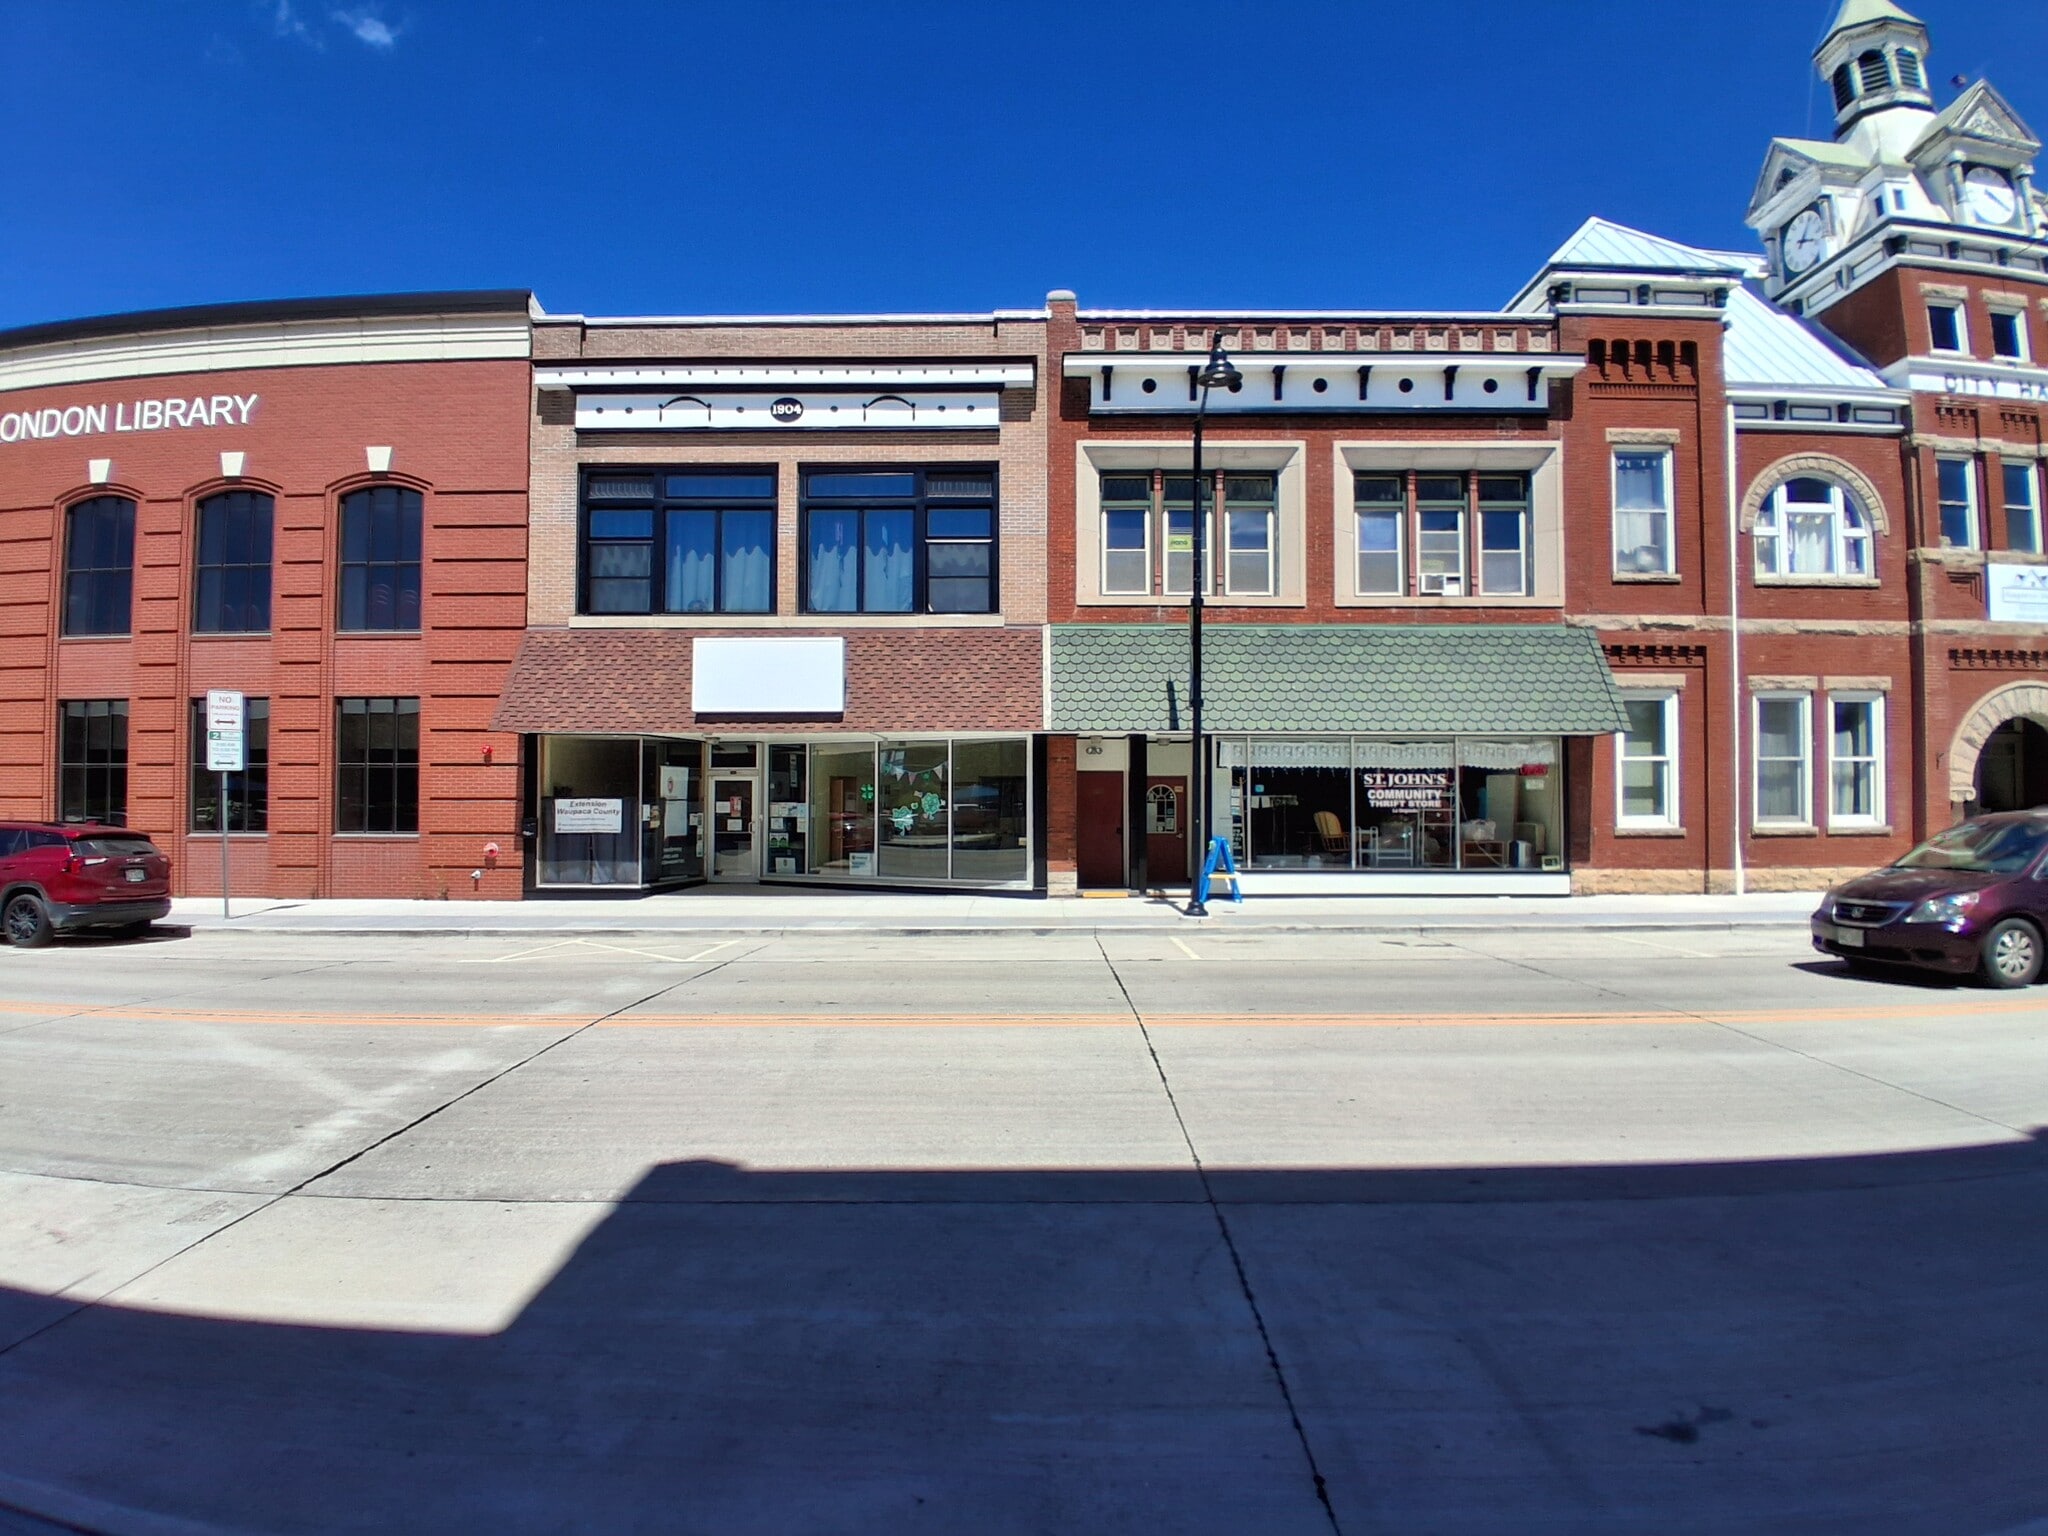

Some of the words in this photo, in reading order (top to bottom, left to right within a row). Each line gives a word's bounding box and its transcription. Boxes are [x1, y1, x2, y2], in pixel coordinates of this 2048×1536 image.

[1943, 373, 2000, 396] CITY
[772, 404, 802, 415] 1904
[0, 403, 107, 442] ONDON
[115, 394, 258, 431] LIBRARY
[1367, 789, 1443, 799] COMMUNITY
[593, 807, 620, 816] County
